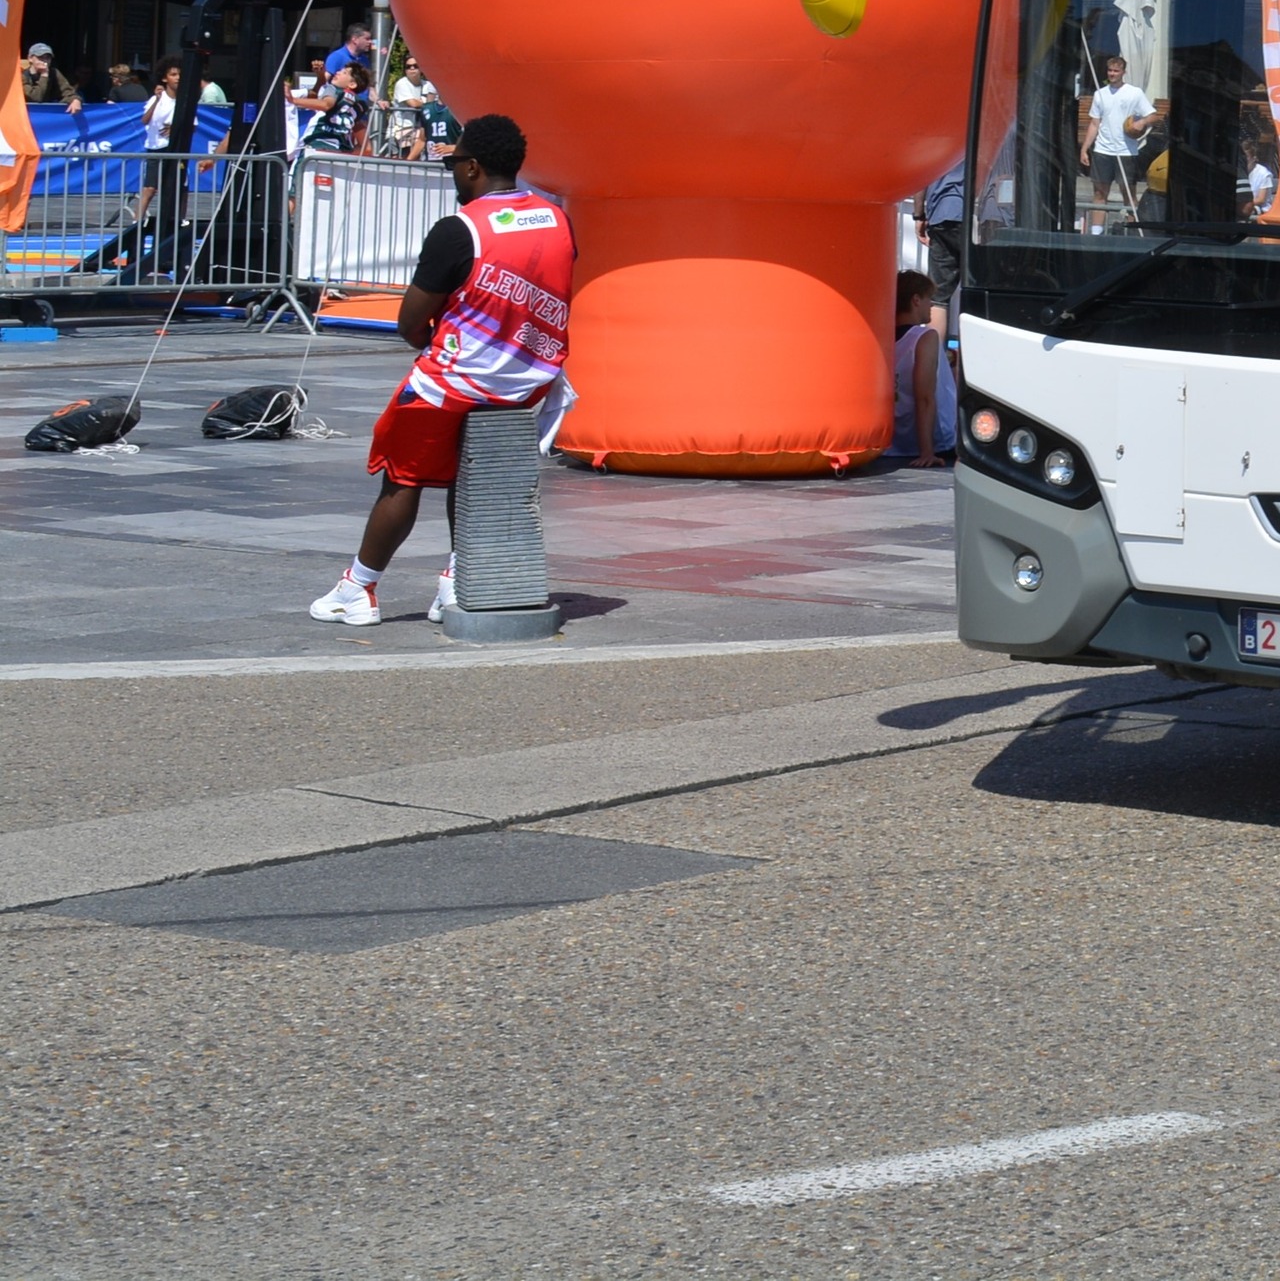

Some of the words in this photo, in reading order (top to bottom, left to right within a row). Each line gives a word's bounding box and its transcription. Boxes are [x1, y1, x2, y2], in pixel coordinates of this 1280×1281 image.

[431, 121, 448, 137] 12
[516, 212, 554, 227] crelan
[474, 263, 570, 332] LEUVEN
[513, 321, 565, 361] 2025
[1244, 634, 1256, 650] B
